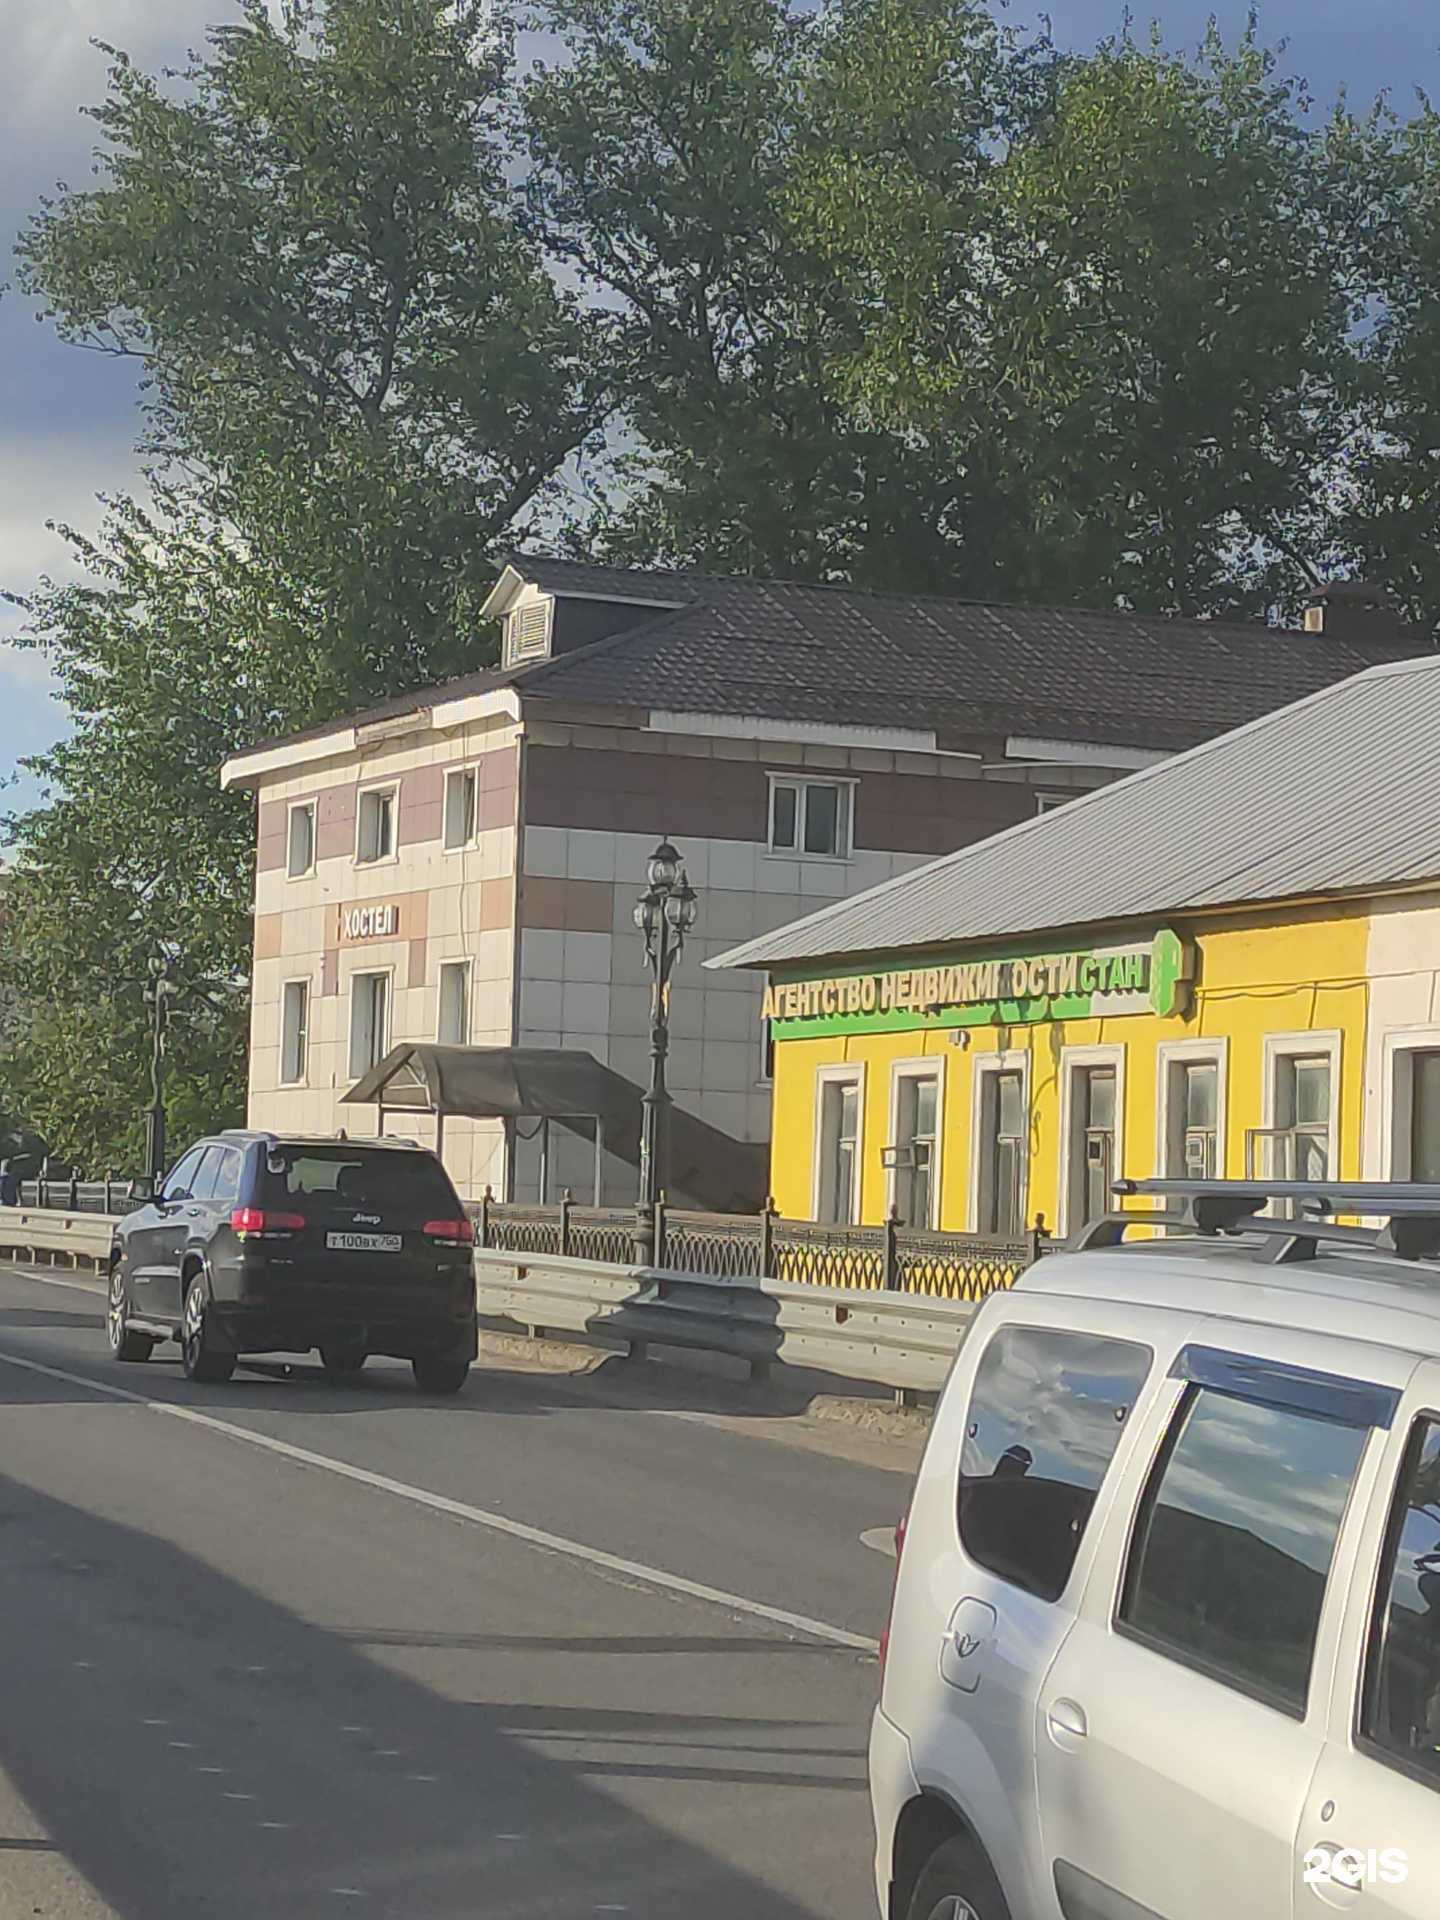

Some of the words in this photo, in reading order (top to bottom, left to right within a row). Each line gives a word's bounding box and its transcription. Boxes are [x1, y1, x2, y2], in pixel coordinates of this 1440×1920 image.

[343, 904, 394, 938] ХОСТЕЛ
[761, 974, 876, 1020] АГЕНТСТВО
[1080, 953, 1143, 992] СТАН
[353, 1213, 381, 1225] Jeep
